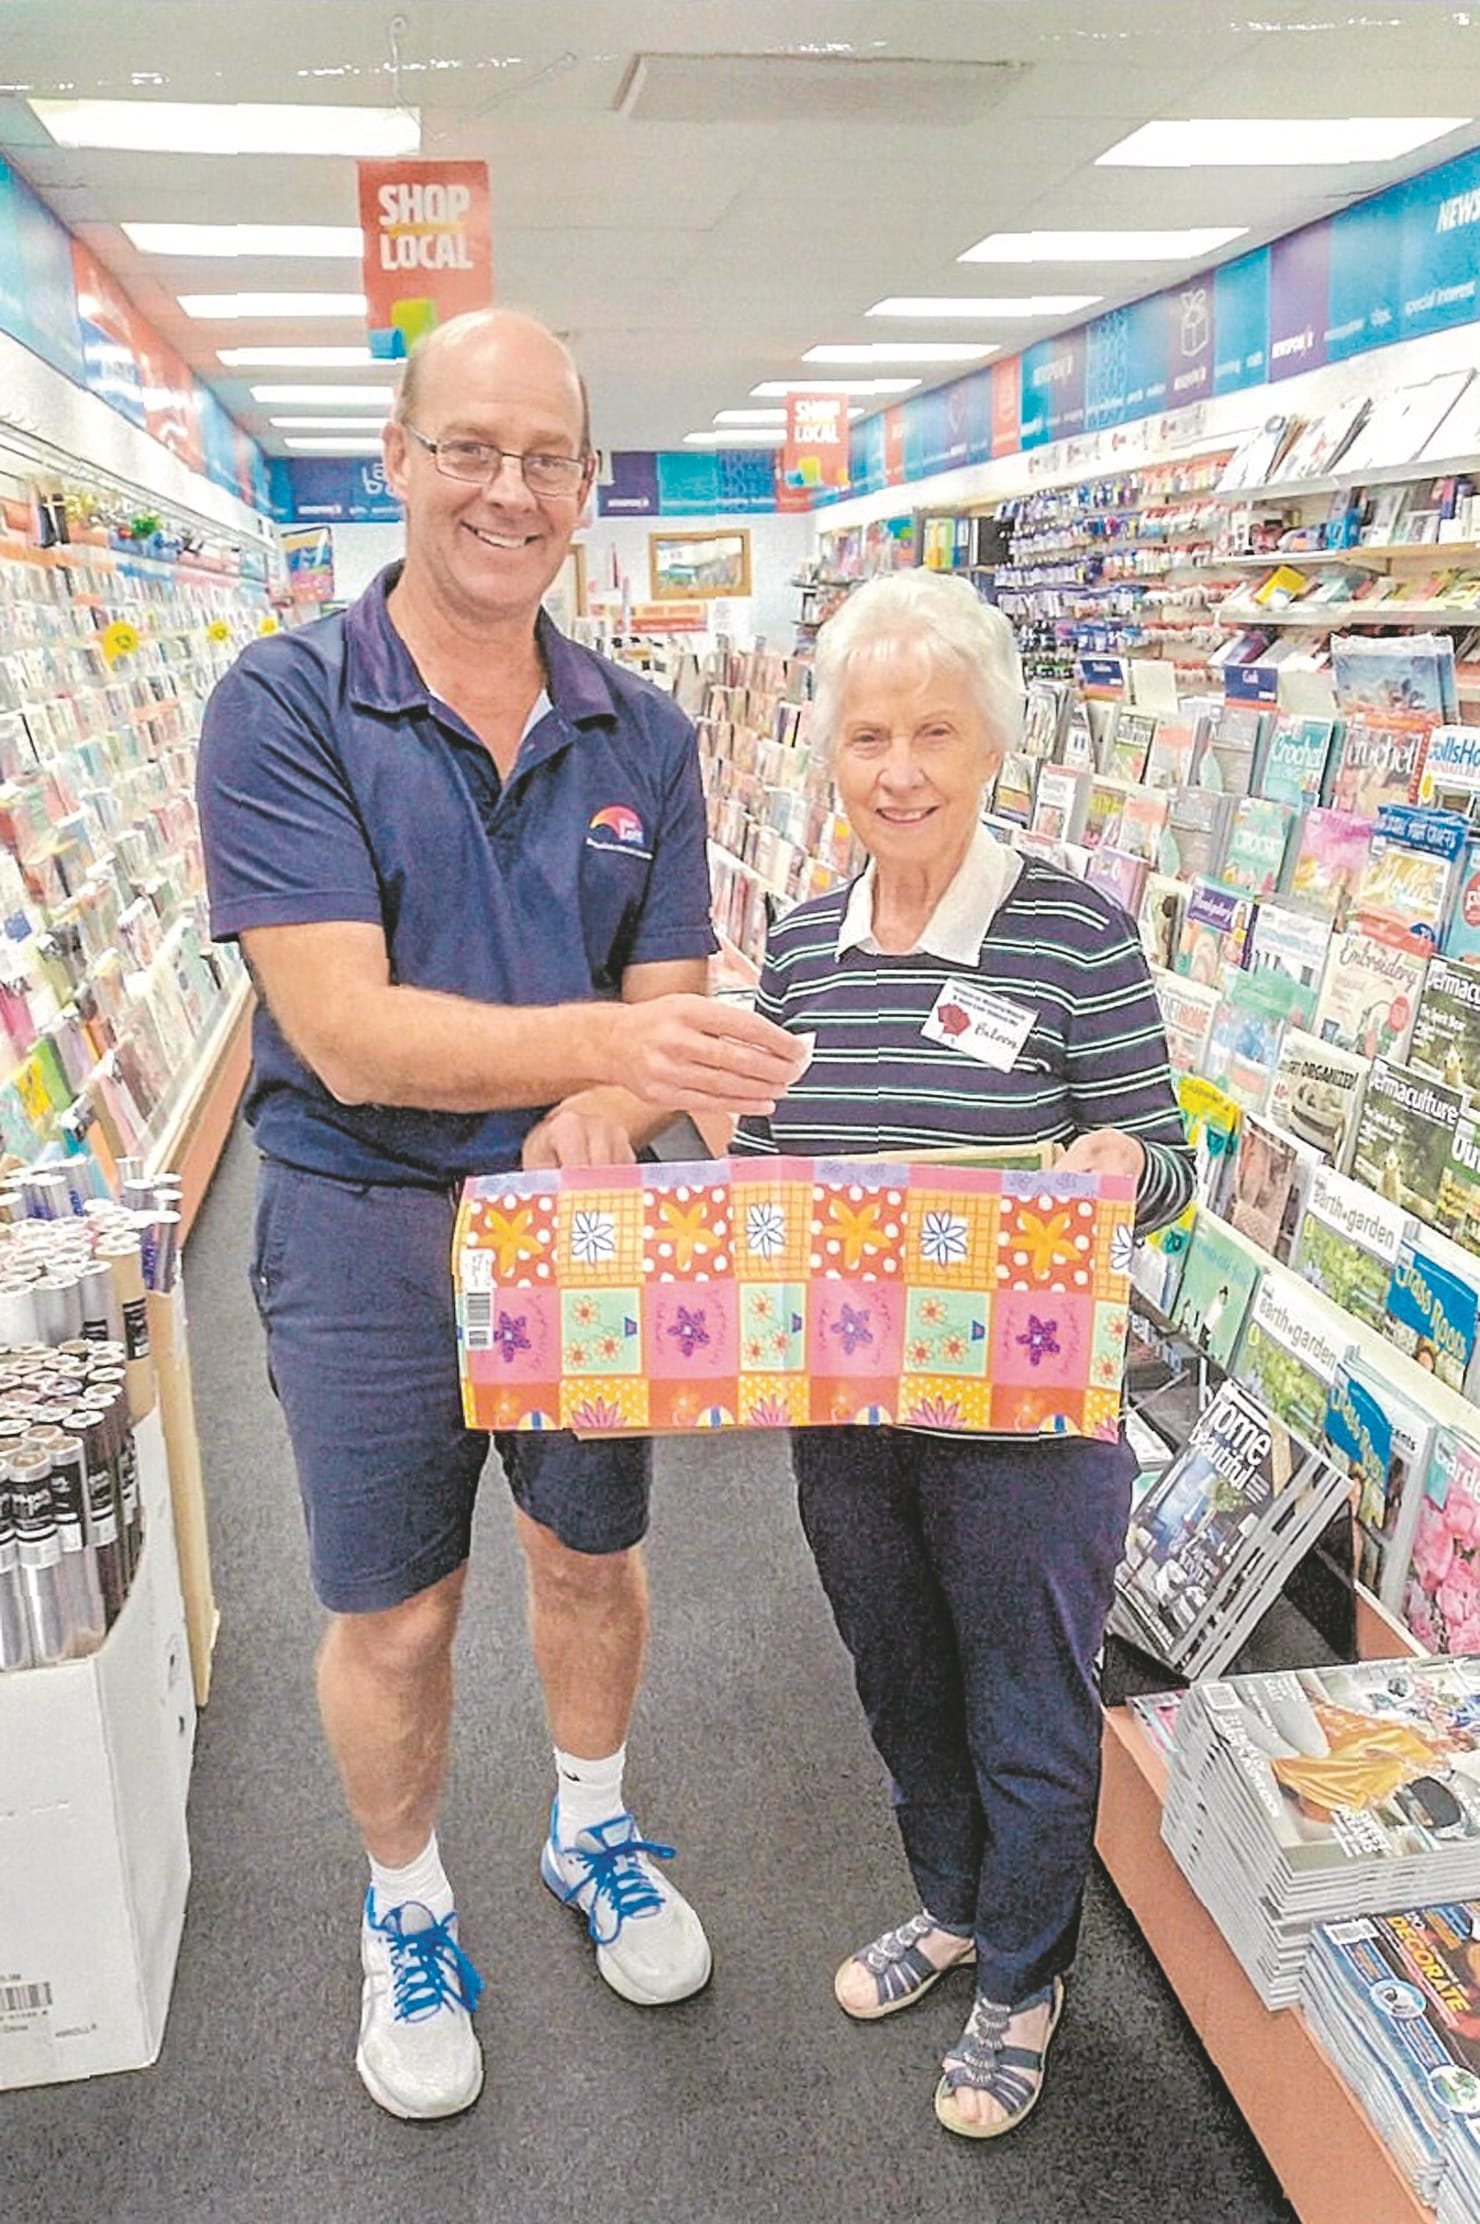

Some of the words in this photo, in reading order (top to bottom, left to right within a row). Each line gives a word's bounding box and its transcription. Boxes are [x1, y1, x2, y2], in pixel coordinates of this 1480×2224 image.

[378, 183, 470, 226] SHOP
[379, 232, 475, 271] LOCAL
[794, 423, 841, 444] LOCAL
[1301, 1061, 1360, 1092] ORGANIZED!
[1312, 1191, 1344, 1219] earth
[1348, 1209, 1395, 1250] garden
[1258, 1298, 1288, 1332] earth
[1292, 1323, 1338, 1372] garden
[1189, 1427, 1256, 1492] beautiful
[1387, 1915, 1471, 2012] DECORATE
